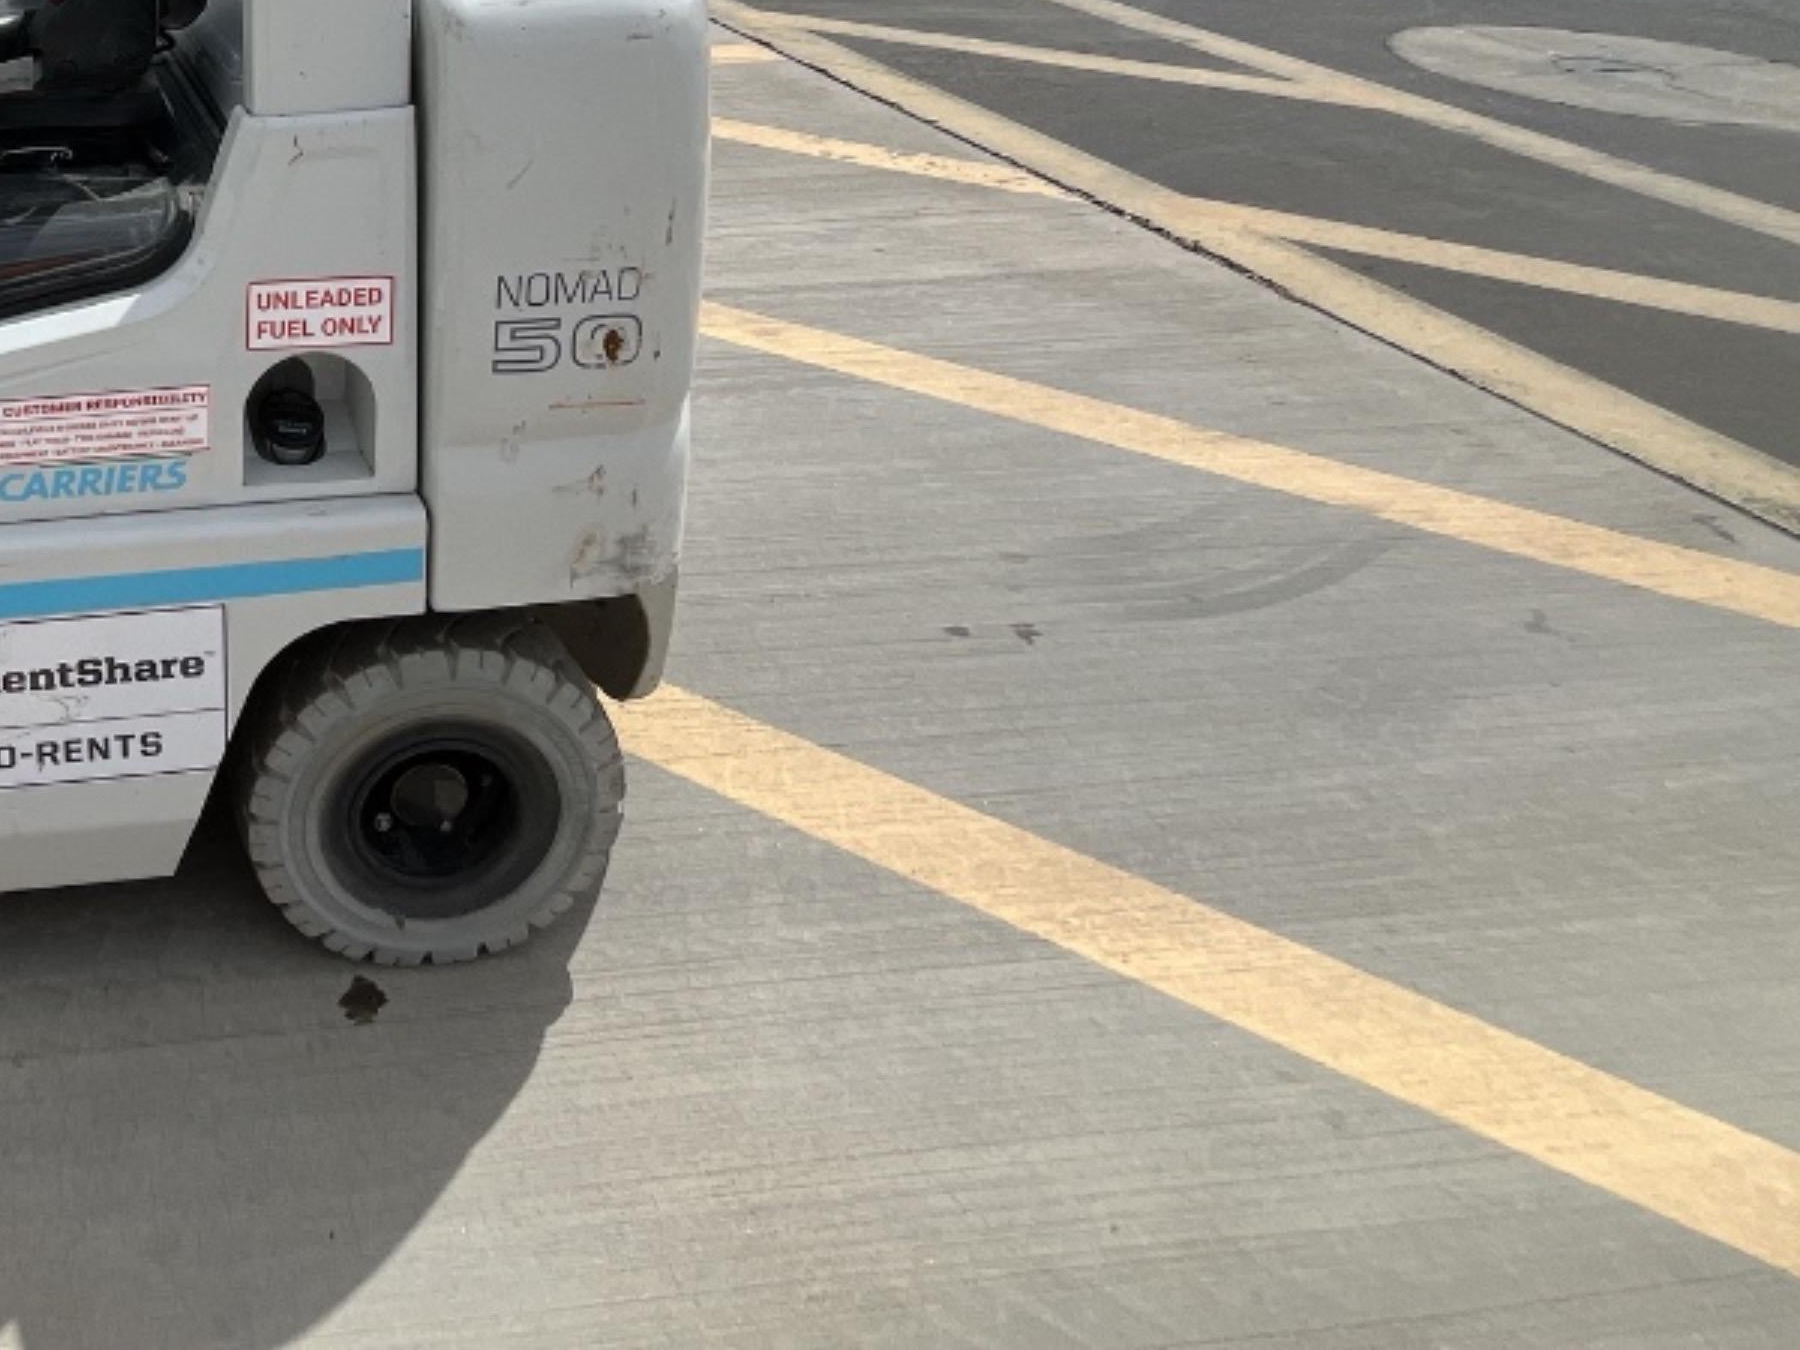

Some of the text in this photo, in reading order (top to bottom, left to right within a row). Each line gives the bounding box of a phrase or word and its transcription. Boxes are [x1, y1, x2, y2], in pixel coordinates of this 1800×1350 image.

[256, 287, 383, 312] UNLEADED
[496, 267, 642, 310] NOMAD
[256, 314, 383, 340] FUEL ONLY
[492, 314, 643, 374] 50
[3, 400, 82, 419] CUSTOMER
